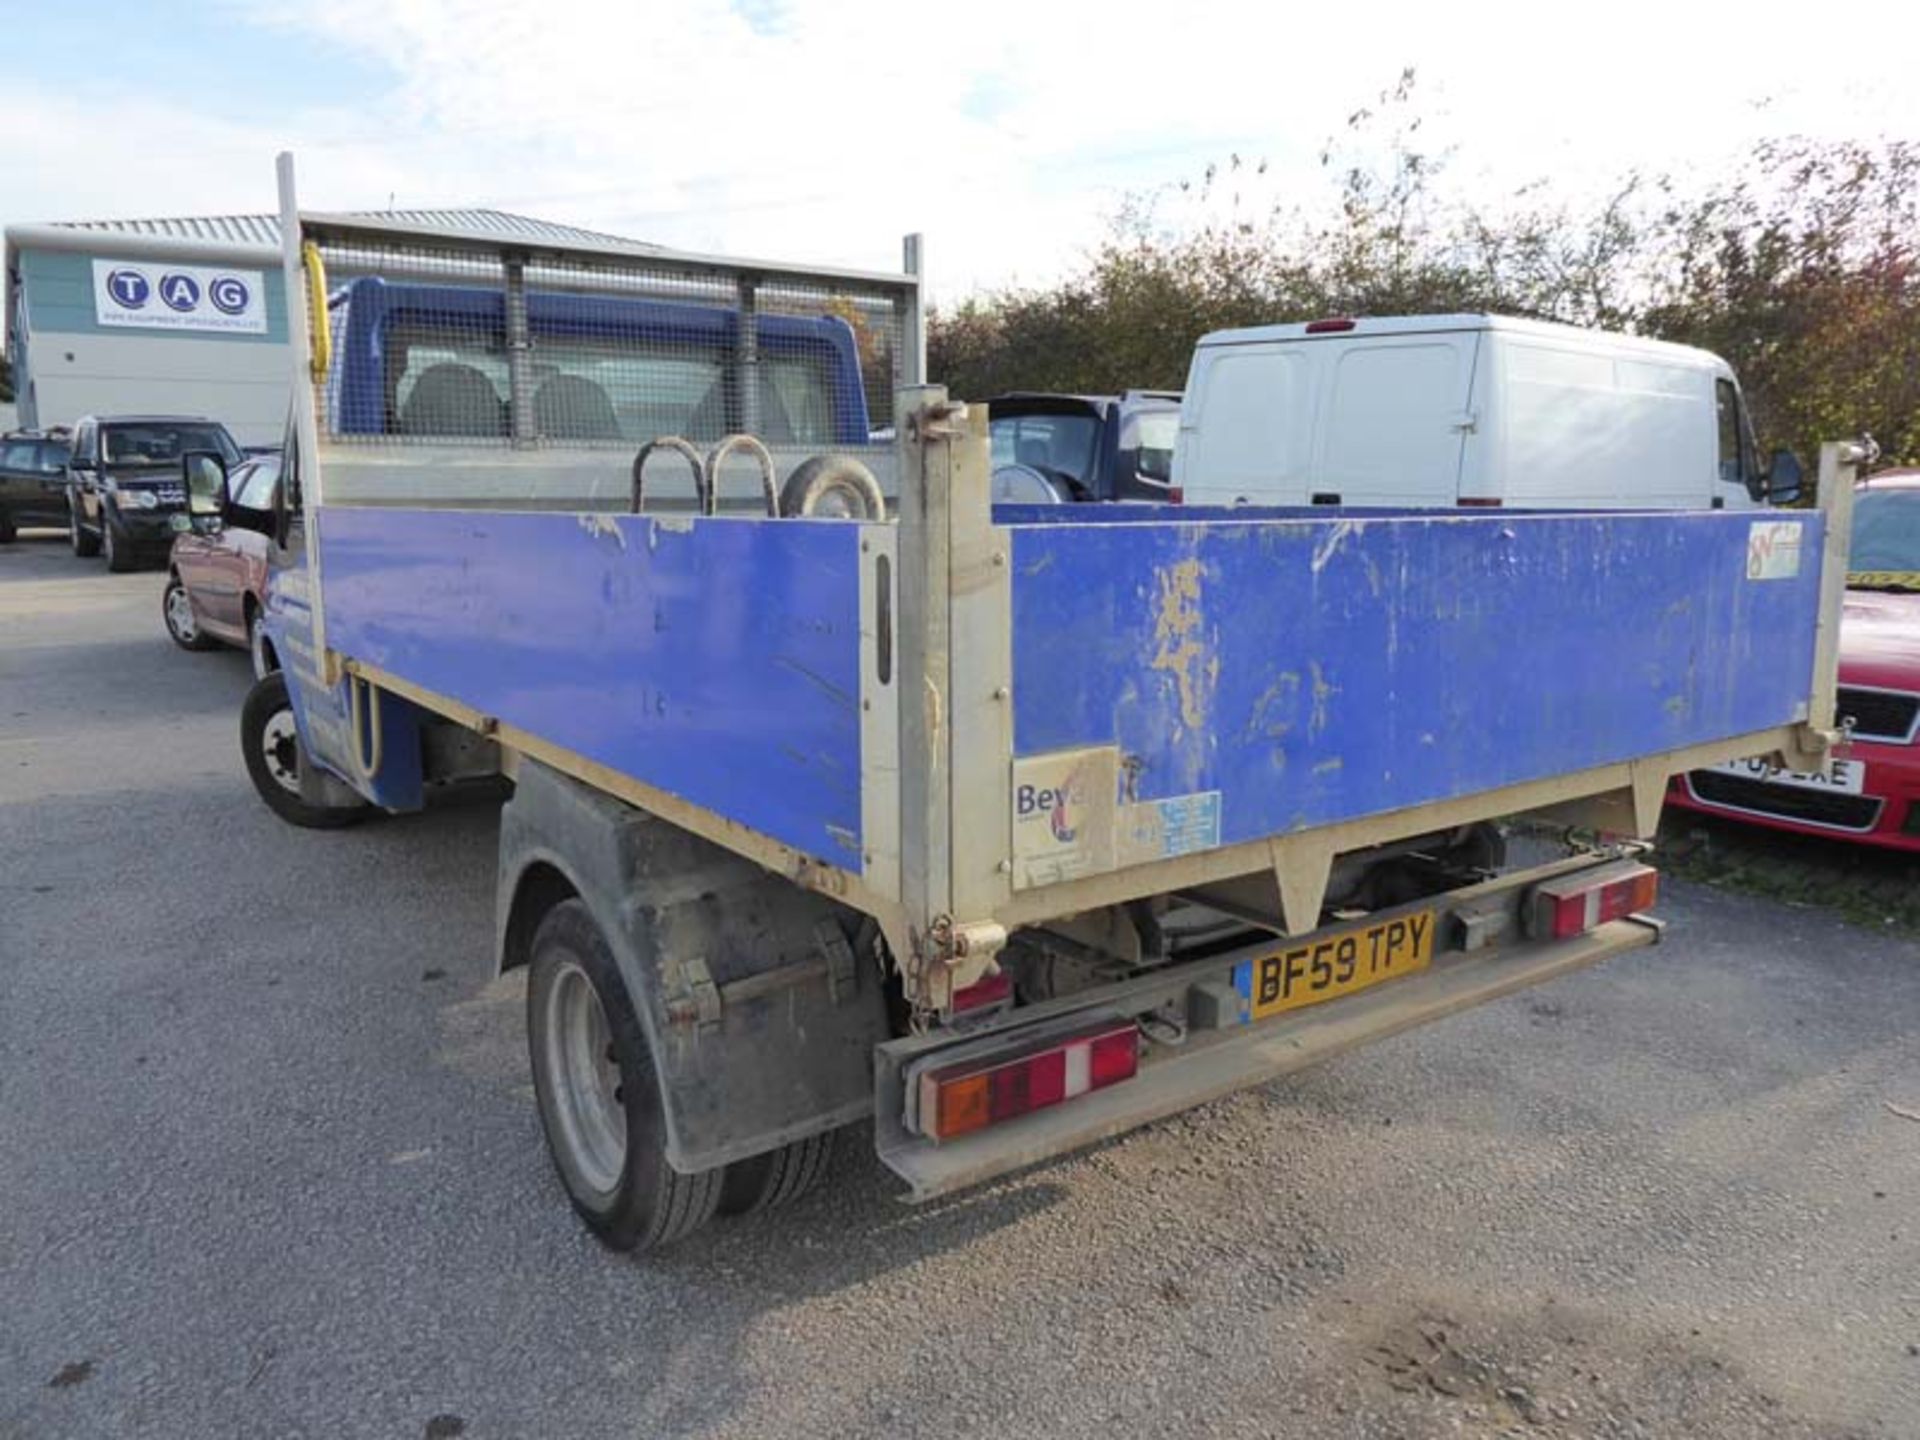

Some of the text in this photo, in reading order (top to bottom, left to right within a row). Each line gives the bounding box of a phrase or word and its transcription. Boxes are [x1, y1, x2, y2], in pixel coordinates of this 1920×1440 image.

[115, 274, 243, 307] TAG
[1257, 913, 1429, 1006] BF59 TPY
